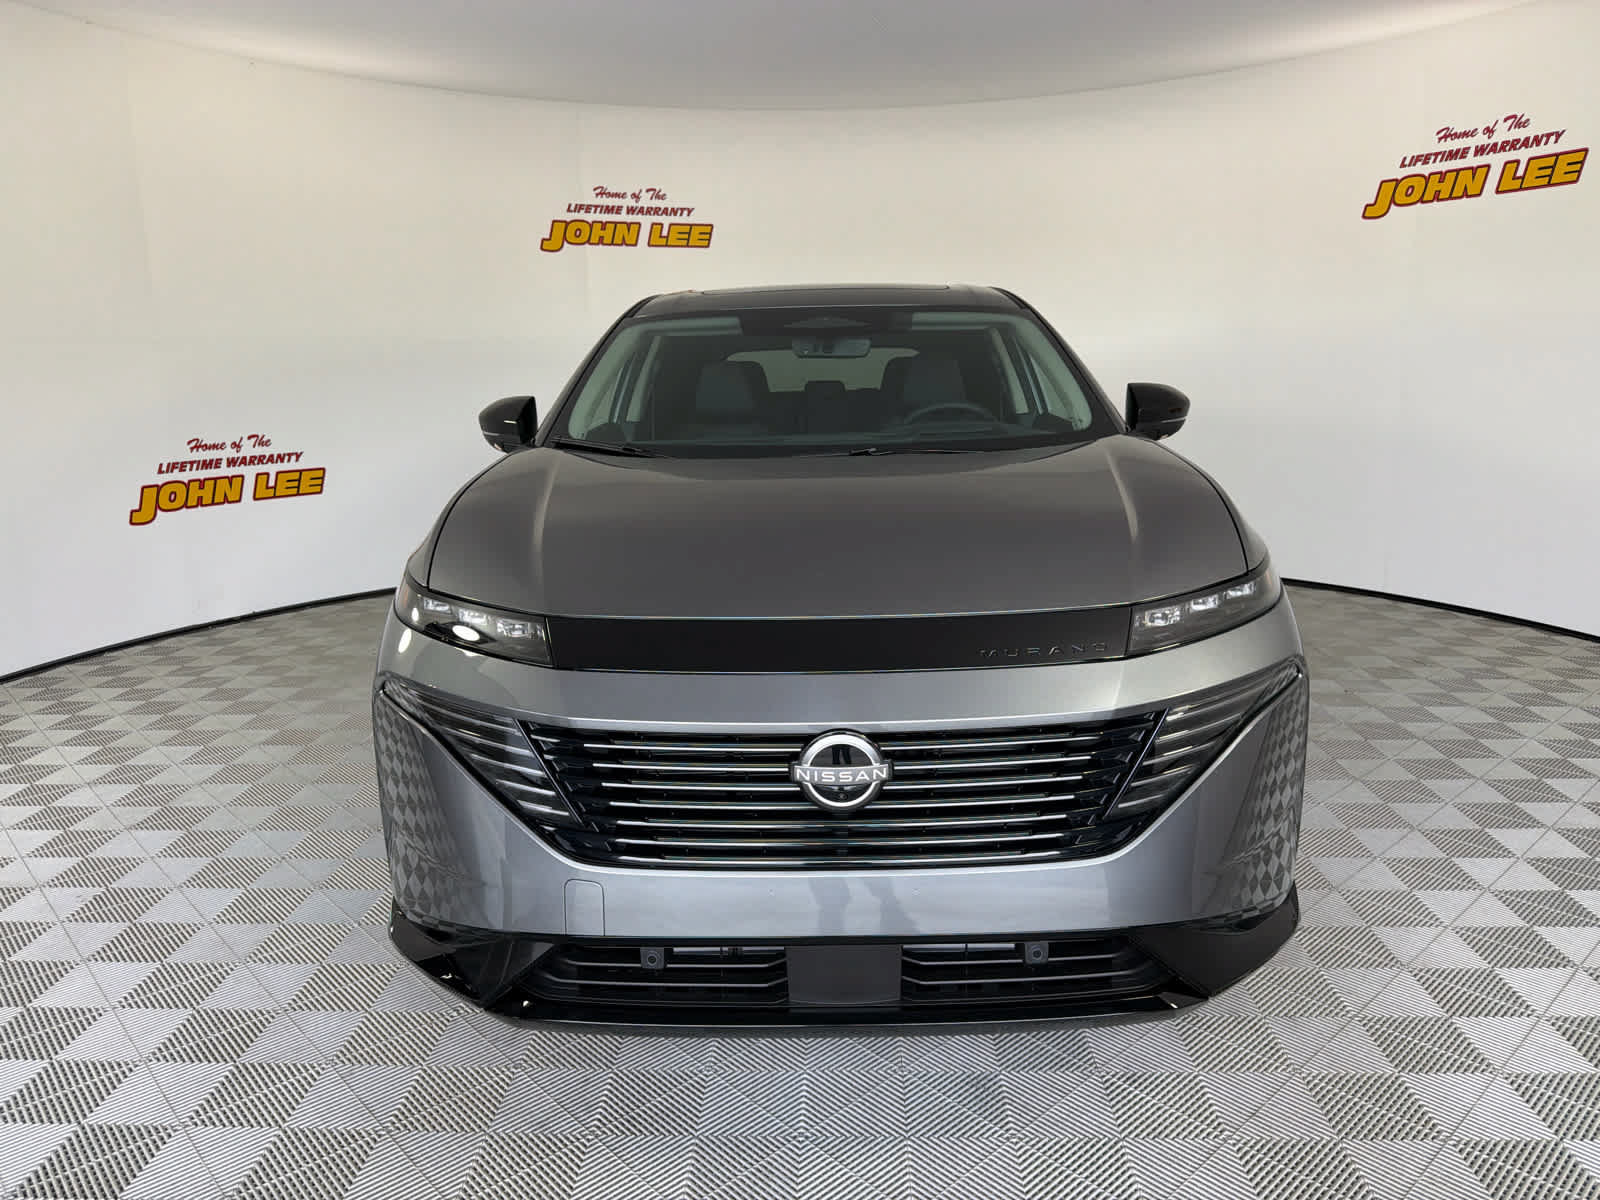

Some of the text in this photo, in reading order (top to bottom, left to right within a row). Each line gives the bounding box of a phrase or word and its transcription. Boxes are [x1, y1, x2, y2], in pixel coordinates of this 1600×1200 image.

[1436, 114, 1530, 144] Home of The
[1400, 129, 1567, 169] LIFETIME WARRANTY
[593, 186, 667, 203] Home of The
[1361, 147, 1590, 220] JOHN LEE
[566, 203, 695, 217] LIFETIME WARRANTY
[540, 219, 714, 253] JOHN LEE
[187, 434, 272, 453] Home of The
[157, 451, 304, 475] LIFETIME WARRANTY
[129, 467, 326, 526] JOHN LEE
[979, 641, 1107, 657] MURANO
[796, 767, 887, 782] NISSAN
